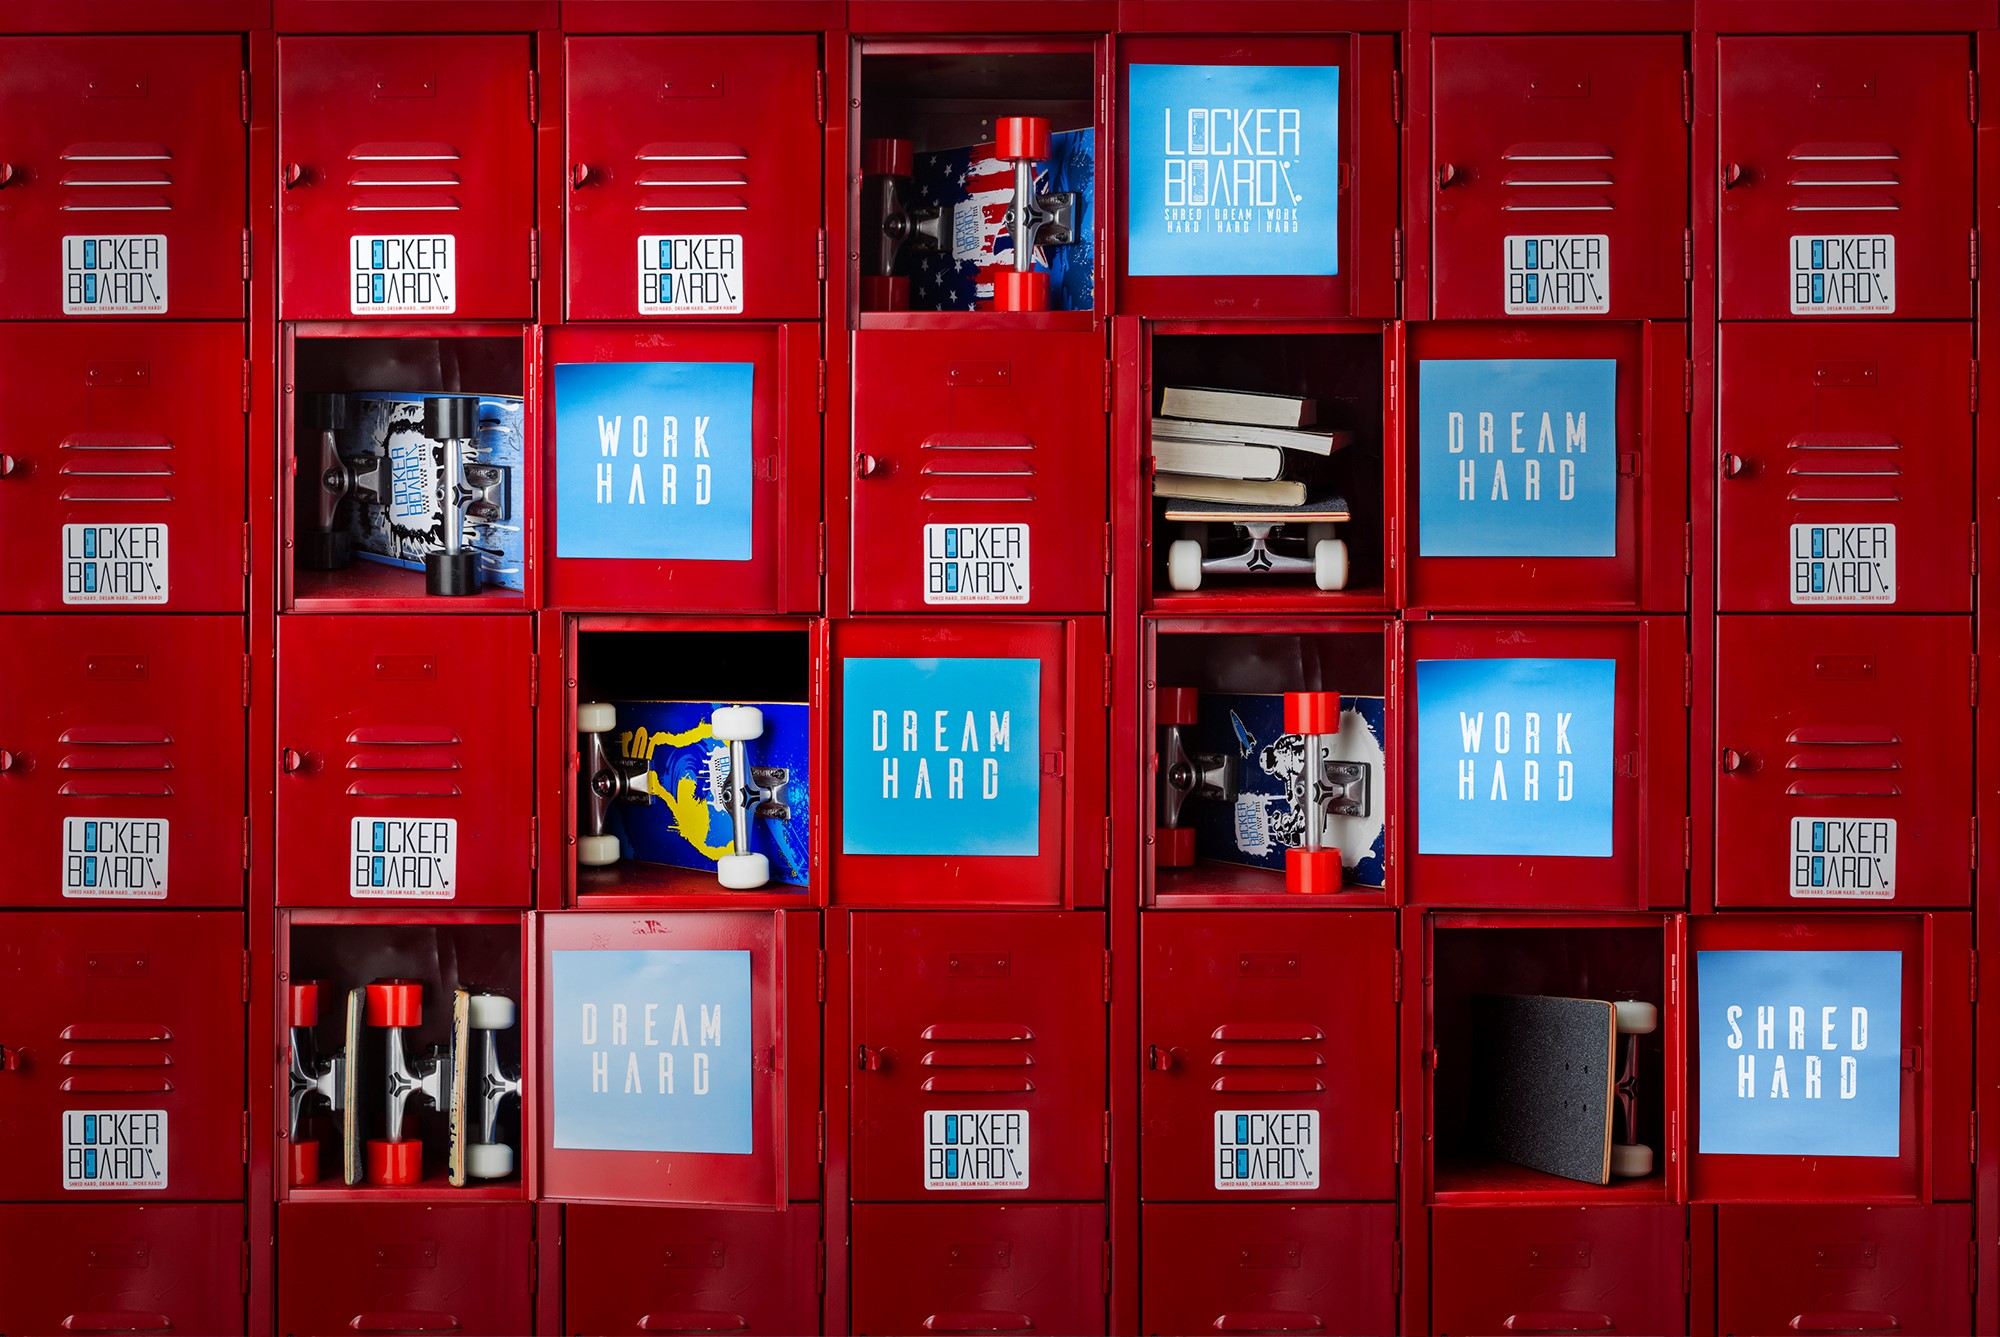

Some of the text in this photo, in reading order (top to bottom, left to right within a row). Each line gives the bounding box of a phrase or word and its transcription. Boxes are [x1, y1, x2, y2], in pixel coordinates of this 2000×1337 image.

[1165, 108, 1300, 156] LOCKER
[1165, 159, 1277, 206] BOARD
[1164, 208, 1298, 221] SHRED DREAM WORK
[1168, 221, 1199, 233] HARD
[68, 239, 158, 270] LOCKER
[356, 239, 446, 270] LOCKER
[644, 239, 733, 270] LOCKER
[1510, 239, 1600, 270] LOCKER
[1796, 239, 1885, 270] LOCKER
[69, 273, 143, 303] BOARD
[357, 273, 431, 303] BOARD
[644, 273, 718, 303] BOARD
[1510, 273, 1585, 303] BOARD
[1796, 273, 1871, 303] BOARD
[598, 415, 711, 457] WORK
[1449, 412, 1586, 453] DREAM
[391, 447, 409, 517] LOCKER
[406, 456, 423, 516] BOARD
[597, 463, 711, 505] HARD
[1459, 460, 1574, 500] HARD
[68, 528, 158, 558] LOCKER
[930, 528, 1020, 558] LOCKER
[1796, 528, 1886, 558] LOCKER
[69, 562, 143, 593] BOARD
[930, 562, 1005, 593] BOARD
[1796, 562, 1871, 593] BOARD
[873, 710, 1010, 752] DREAM
[1460, 712, 1573, 754] WORK
[883, 758, 998, 799] HARD
[1459, 760, 1574, 801] HARD
[69, 821, 160, 853] LOCKER
[357, 821, 447, 853] LOCKER
[1797, 821, 1887, 853] LOCKER
[68, 856, 143, 888] BOARD
[356, 856, 431, 888] BOARD
[1796, 856, 1871, 888] BOARD
[583, 1004, 721, 1046] DREAM
[1727, 1006, 1867, 1050] SHRED
[593, 1053, 708, 1095] HARD
[1738, 1055, 1856, 1099] HARD
[69, 1114, 158, 1145] LOCKER
[930, 1114, 1019, 1145] LOCKER
[1220, 1114, 1310, 1145] LOCKER
[69, 1148, 143, 1179] BOARD
[930, 1148, 1004, 1179] BOARD
[1221, 1148, 1295, 1179] BOARD
